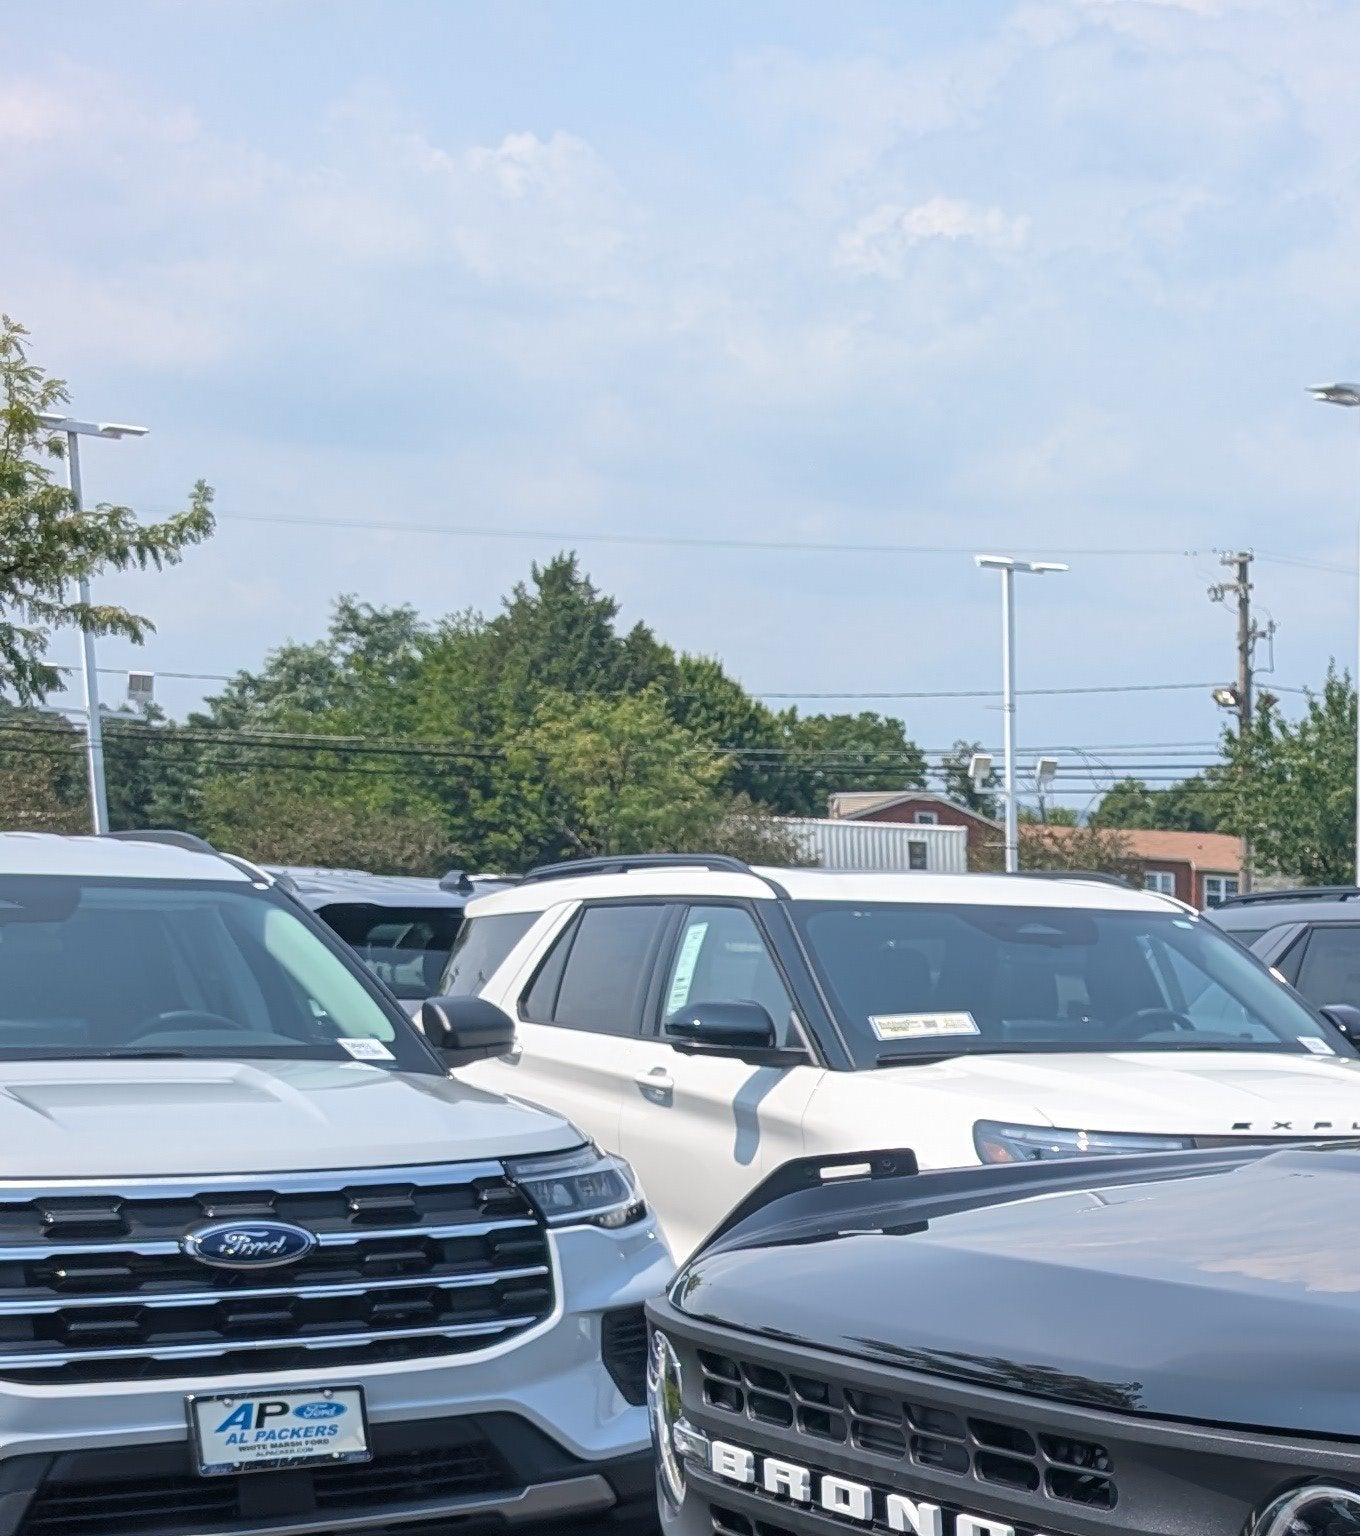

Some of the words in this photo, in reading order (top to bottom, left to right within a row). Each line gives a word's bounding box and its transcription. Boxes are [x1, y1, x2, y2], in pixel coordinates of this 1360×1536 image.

[219, 1229, 288, 1255] Ford
[214, 1401, 290, 1434] AP
[225, 1432, 248, 1446] AL
[254, 1423, 340, 1442] PACKERS
